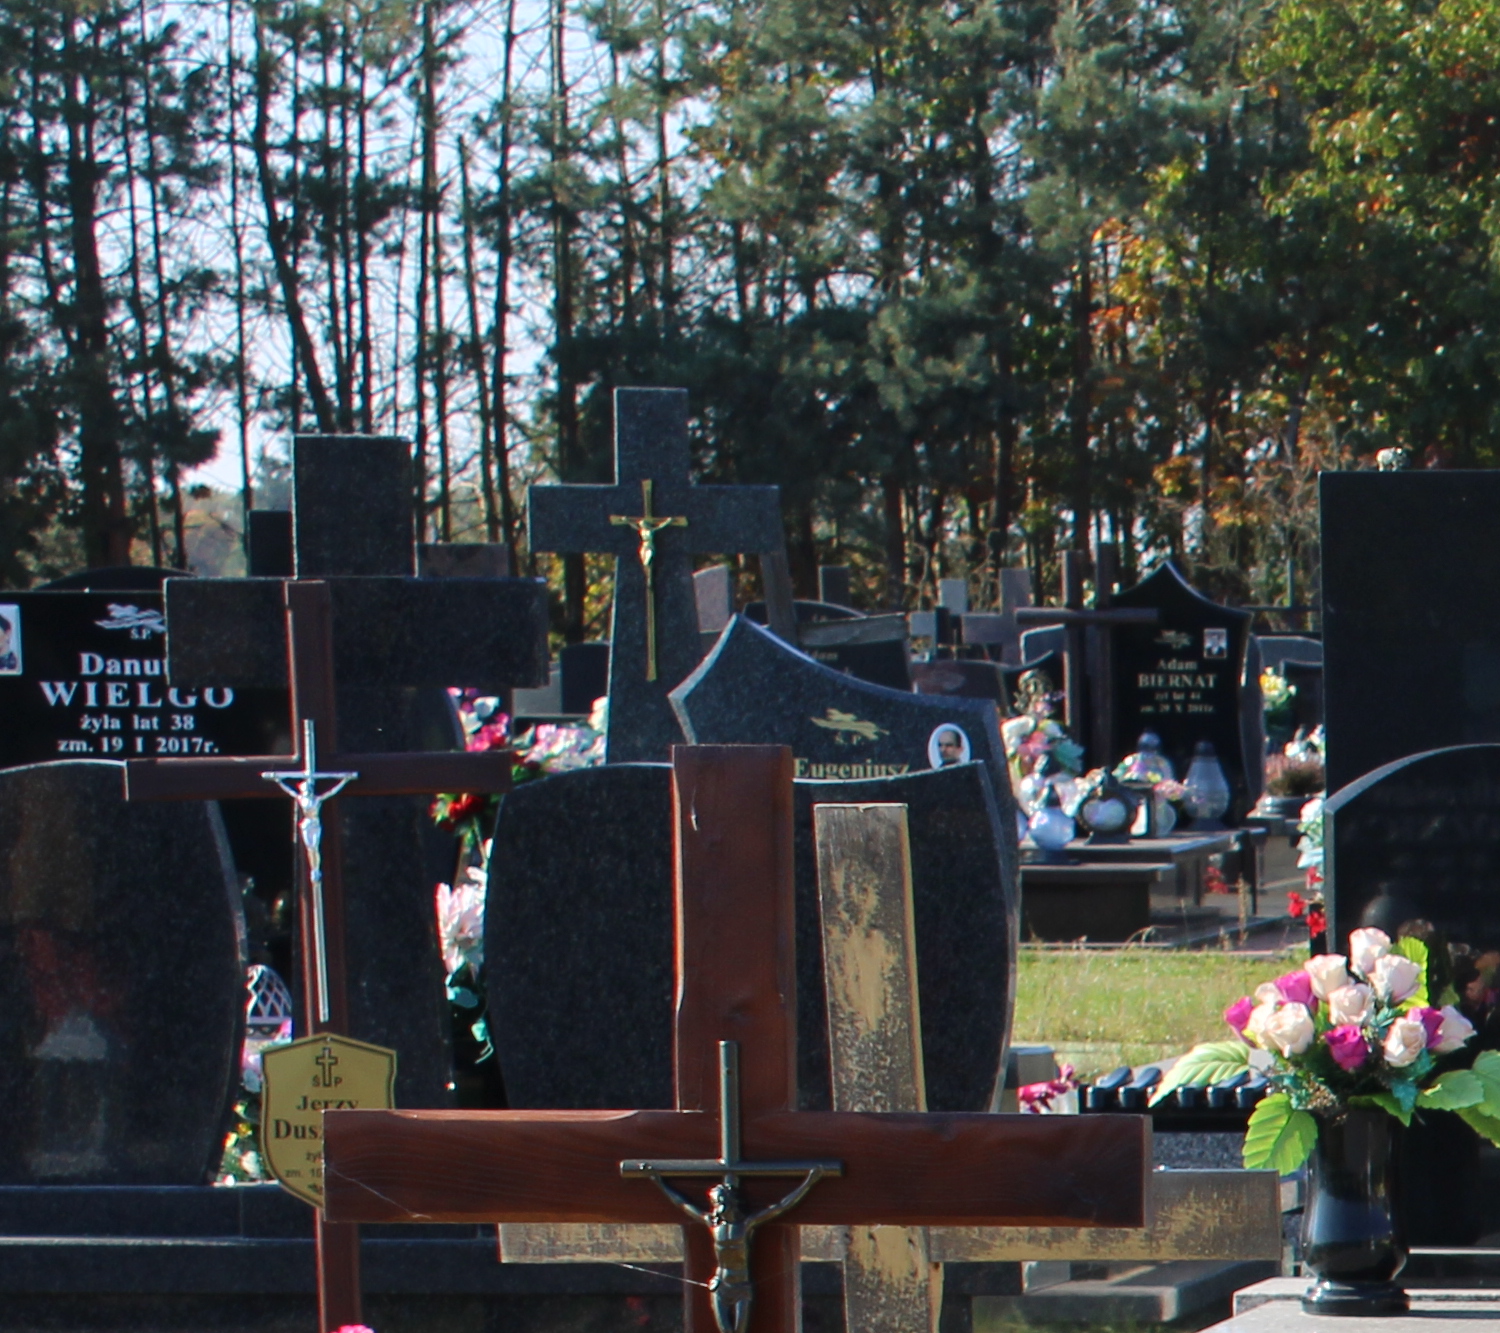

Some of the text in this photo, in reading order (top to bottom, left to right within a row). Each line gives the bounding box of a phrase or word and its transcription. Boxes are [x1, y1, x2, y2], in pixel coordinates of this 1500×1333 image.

[38, 681, 235, 709] WIELGO
[80, 713, 195, 734] żyła lat 38
[101, 736, 124, 753] 19
[155, 736, 220, 754] 2017r.
